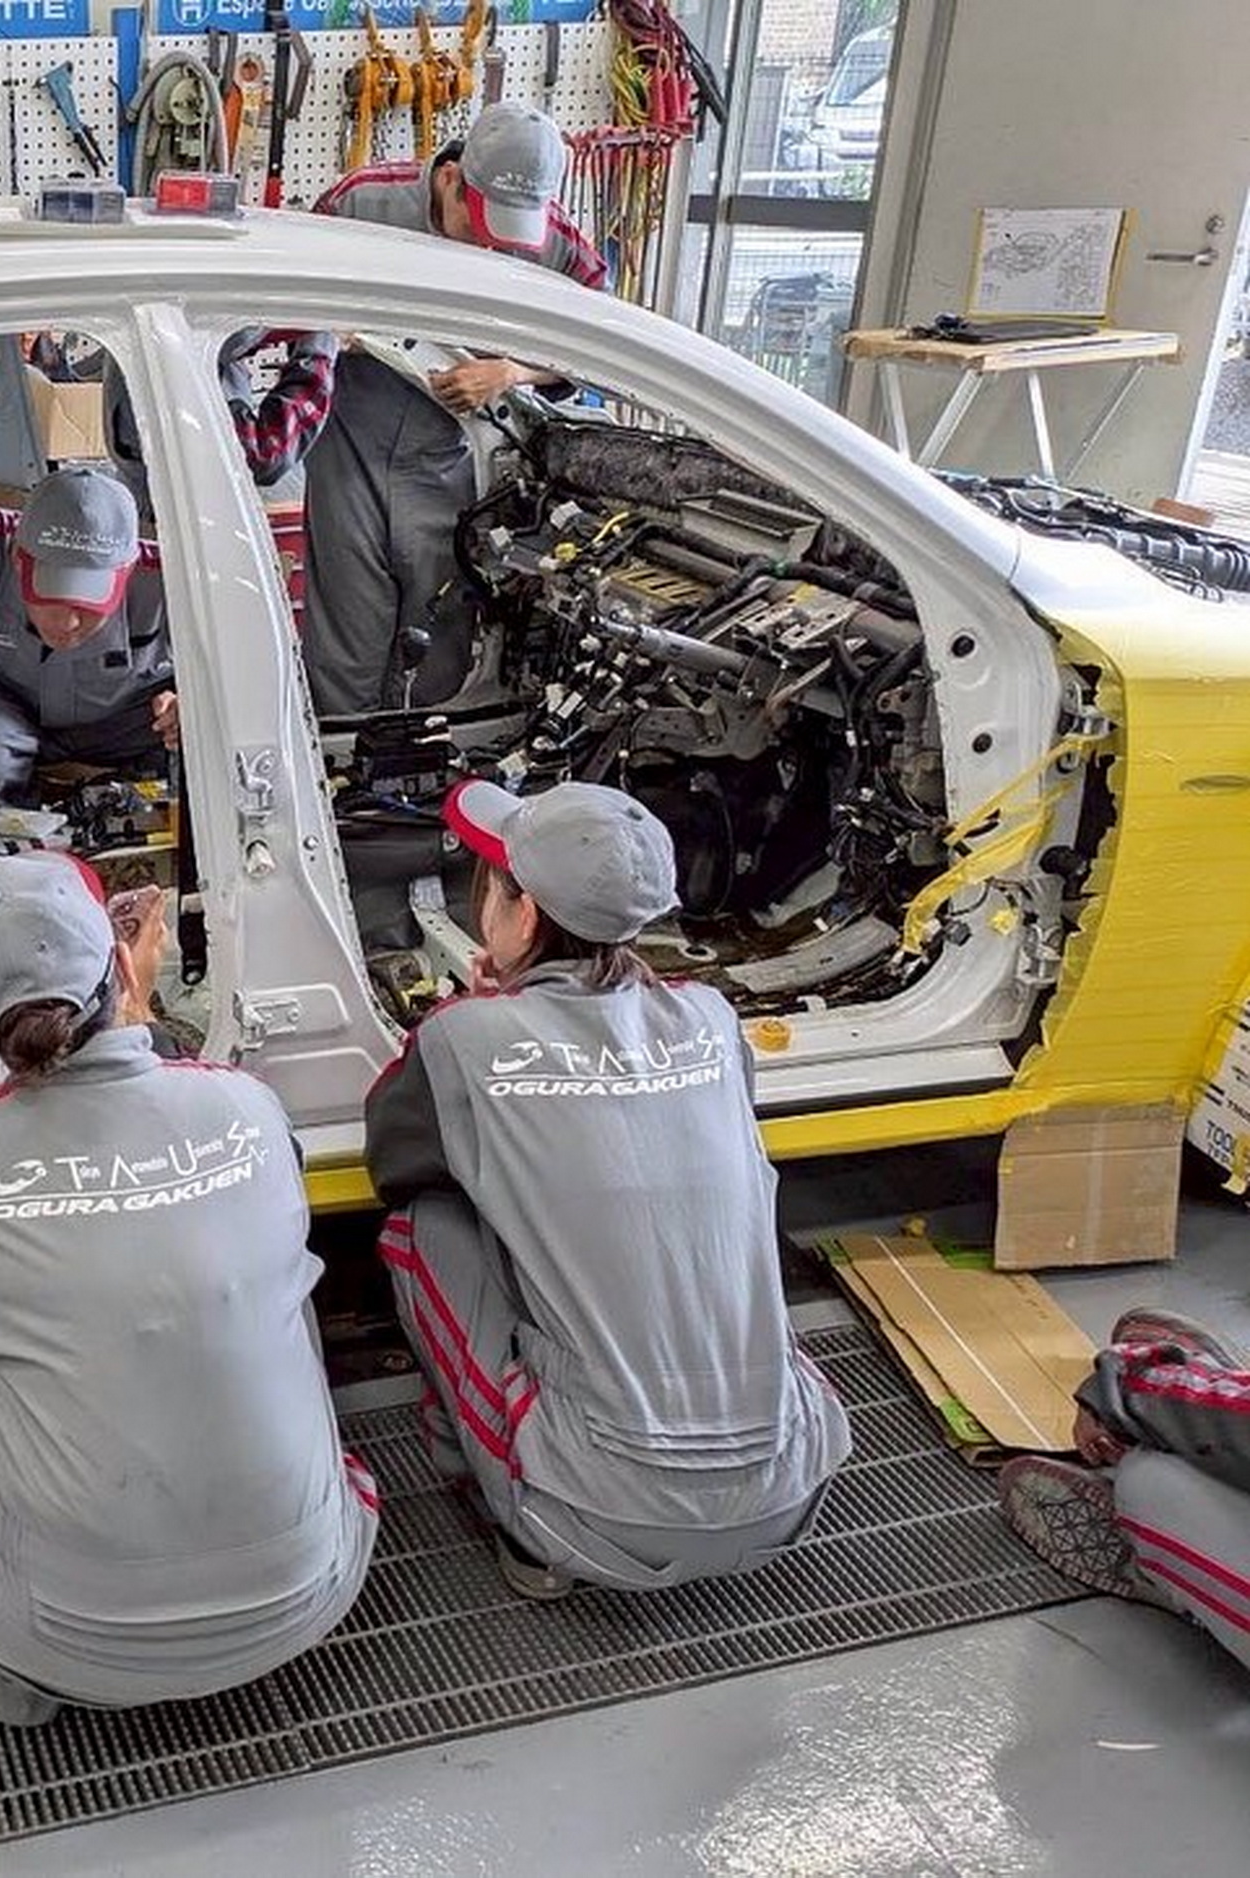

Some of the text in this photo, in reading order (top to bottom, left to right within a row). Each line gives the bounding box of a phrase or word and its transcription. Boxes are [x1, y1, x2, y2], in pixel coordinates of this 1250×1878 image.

[488, 1066, 722, 1097] OGURA GAKUEN
[122, 1162, 253, 1212] GAKUEN
